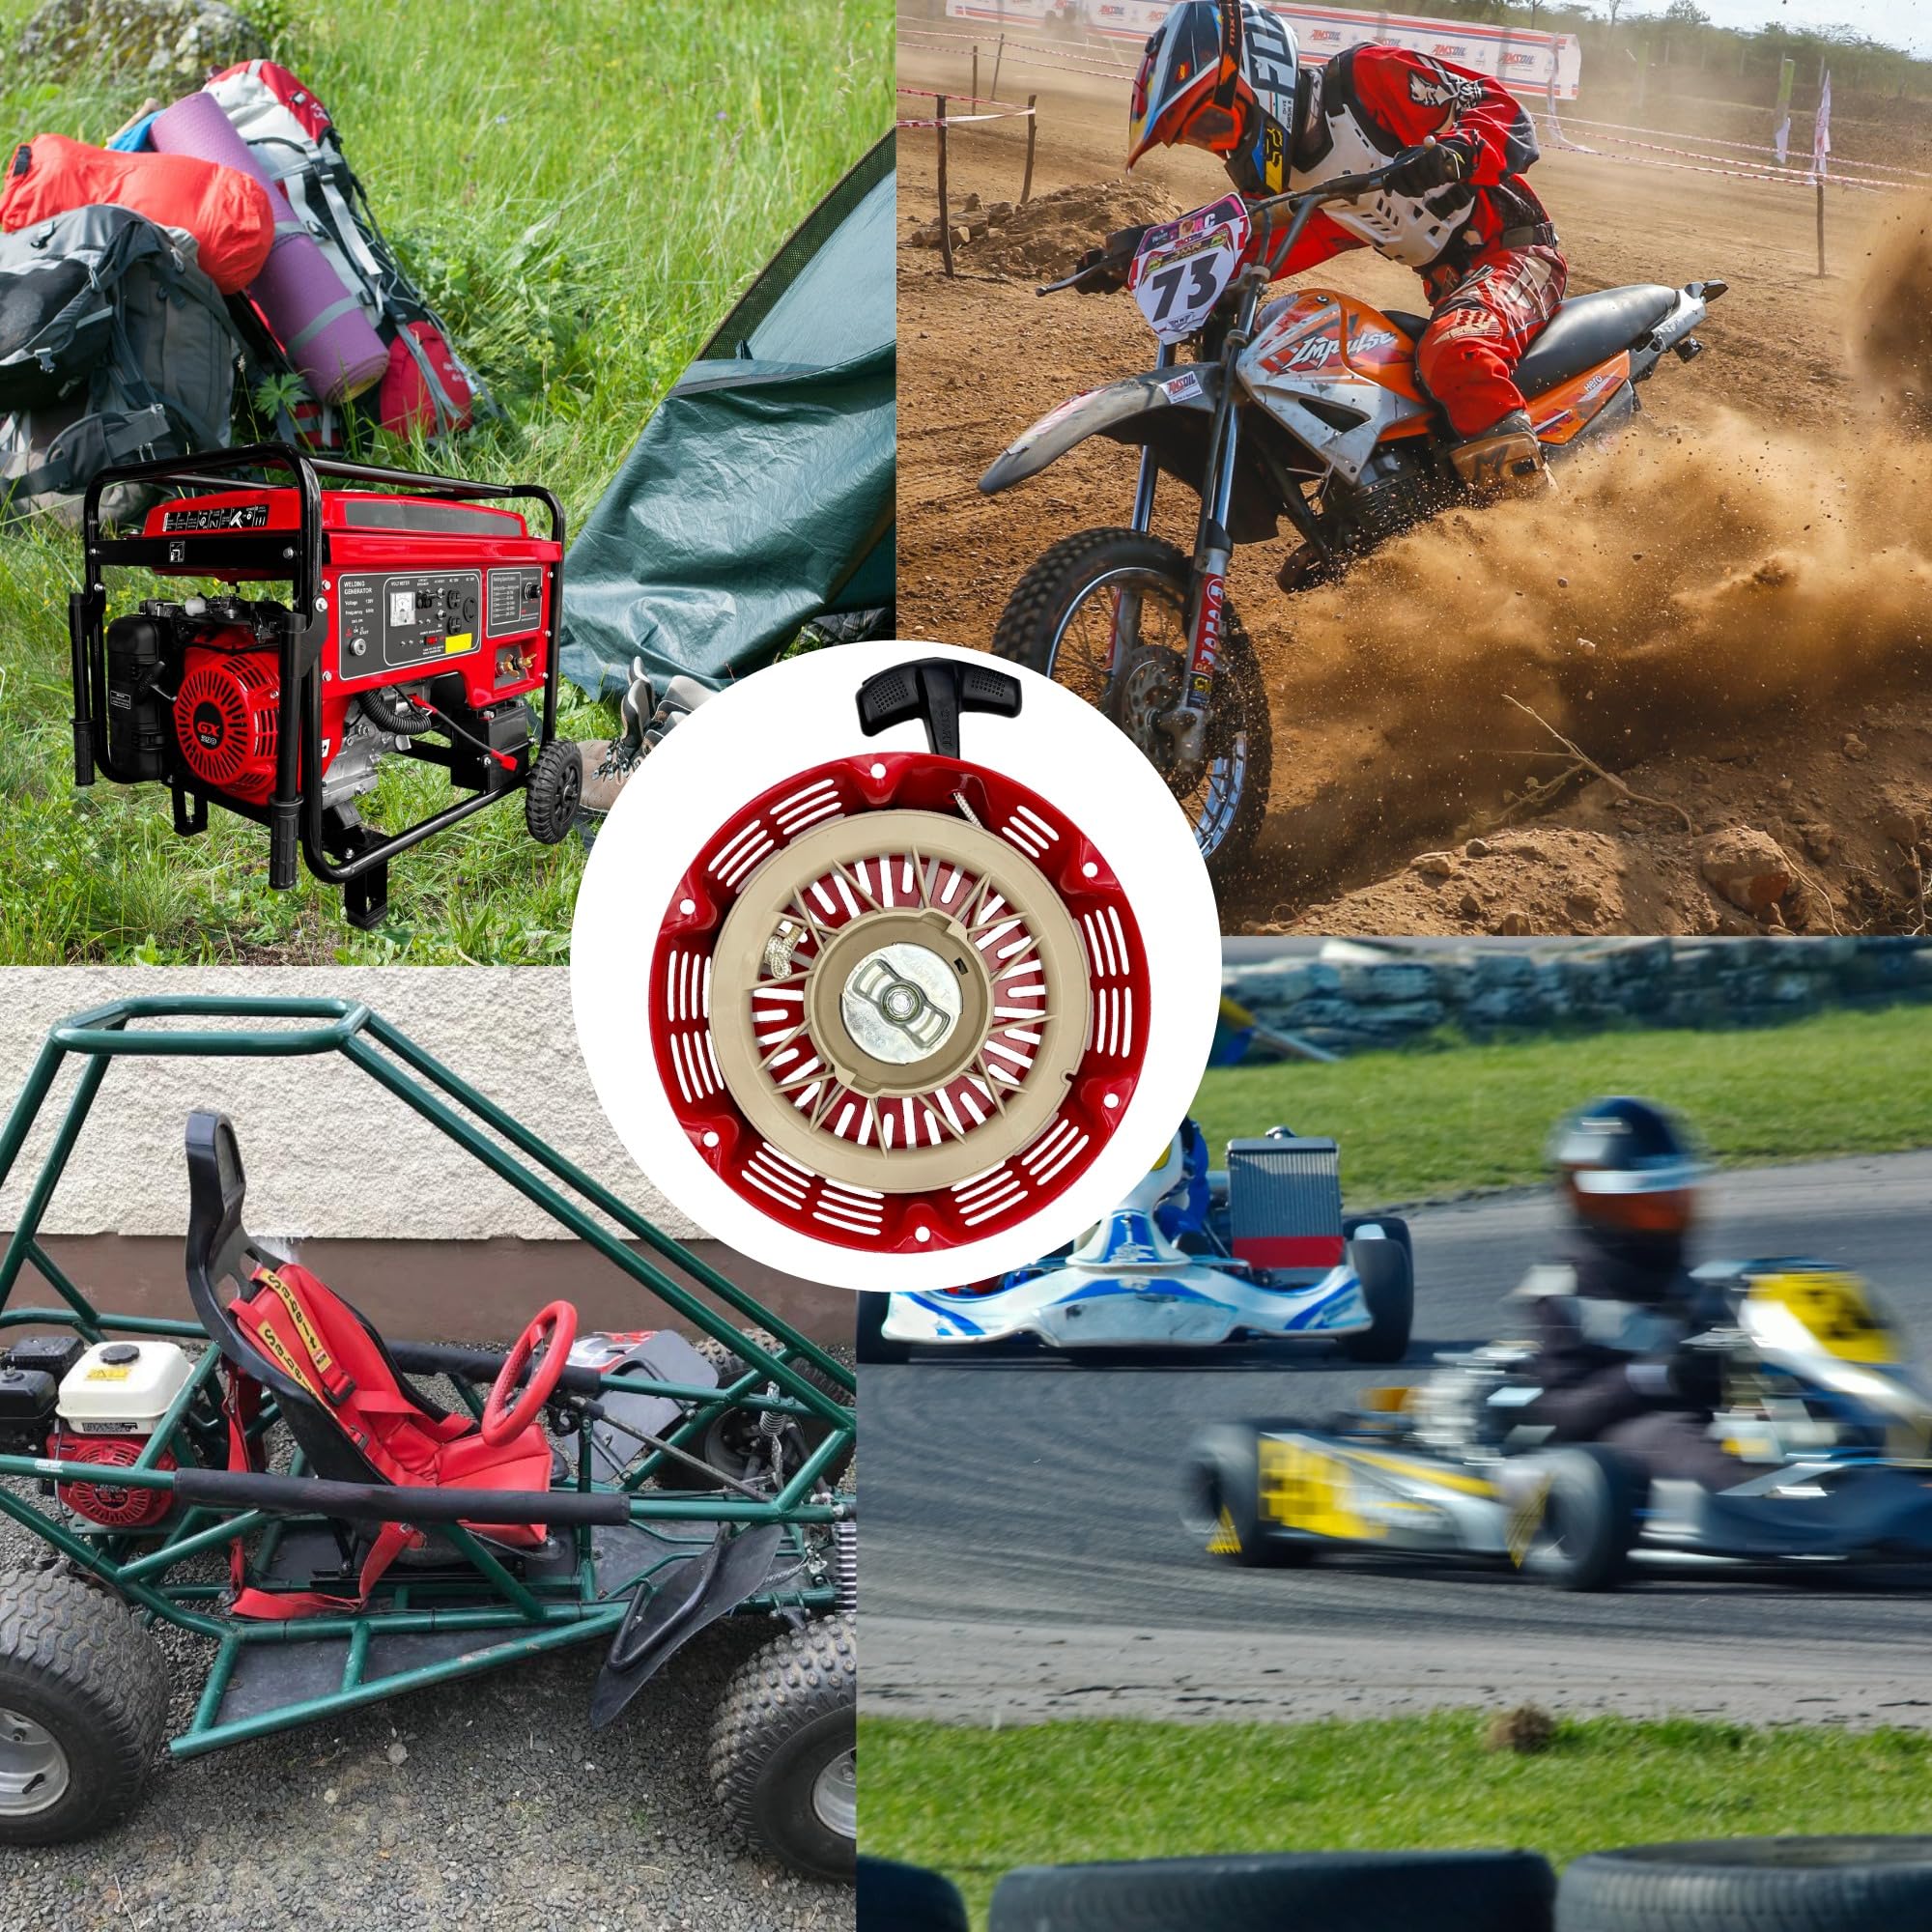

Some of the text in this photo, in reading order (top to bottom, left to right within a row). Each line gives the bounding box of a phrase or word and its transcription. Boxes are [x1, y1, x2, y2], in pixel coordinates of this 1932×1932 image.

[1310, 29, 1341, 42] AMSOIL
[1432, 44, 1466, 56] AMSOIL
[1499, 52, 1535, 65] AMSOIL
[1152, 252, 1219, 323] 73
[1280, 331, 1397, 371] Impulse
[1167, 373, 1196, 395] AMSOIL
[1583, 374, 1604, 392] Hero
[197, 721, 220, 737] GX
[268, 1273, 318, 1350] Sabelt
